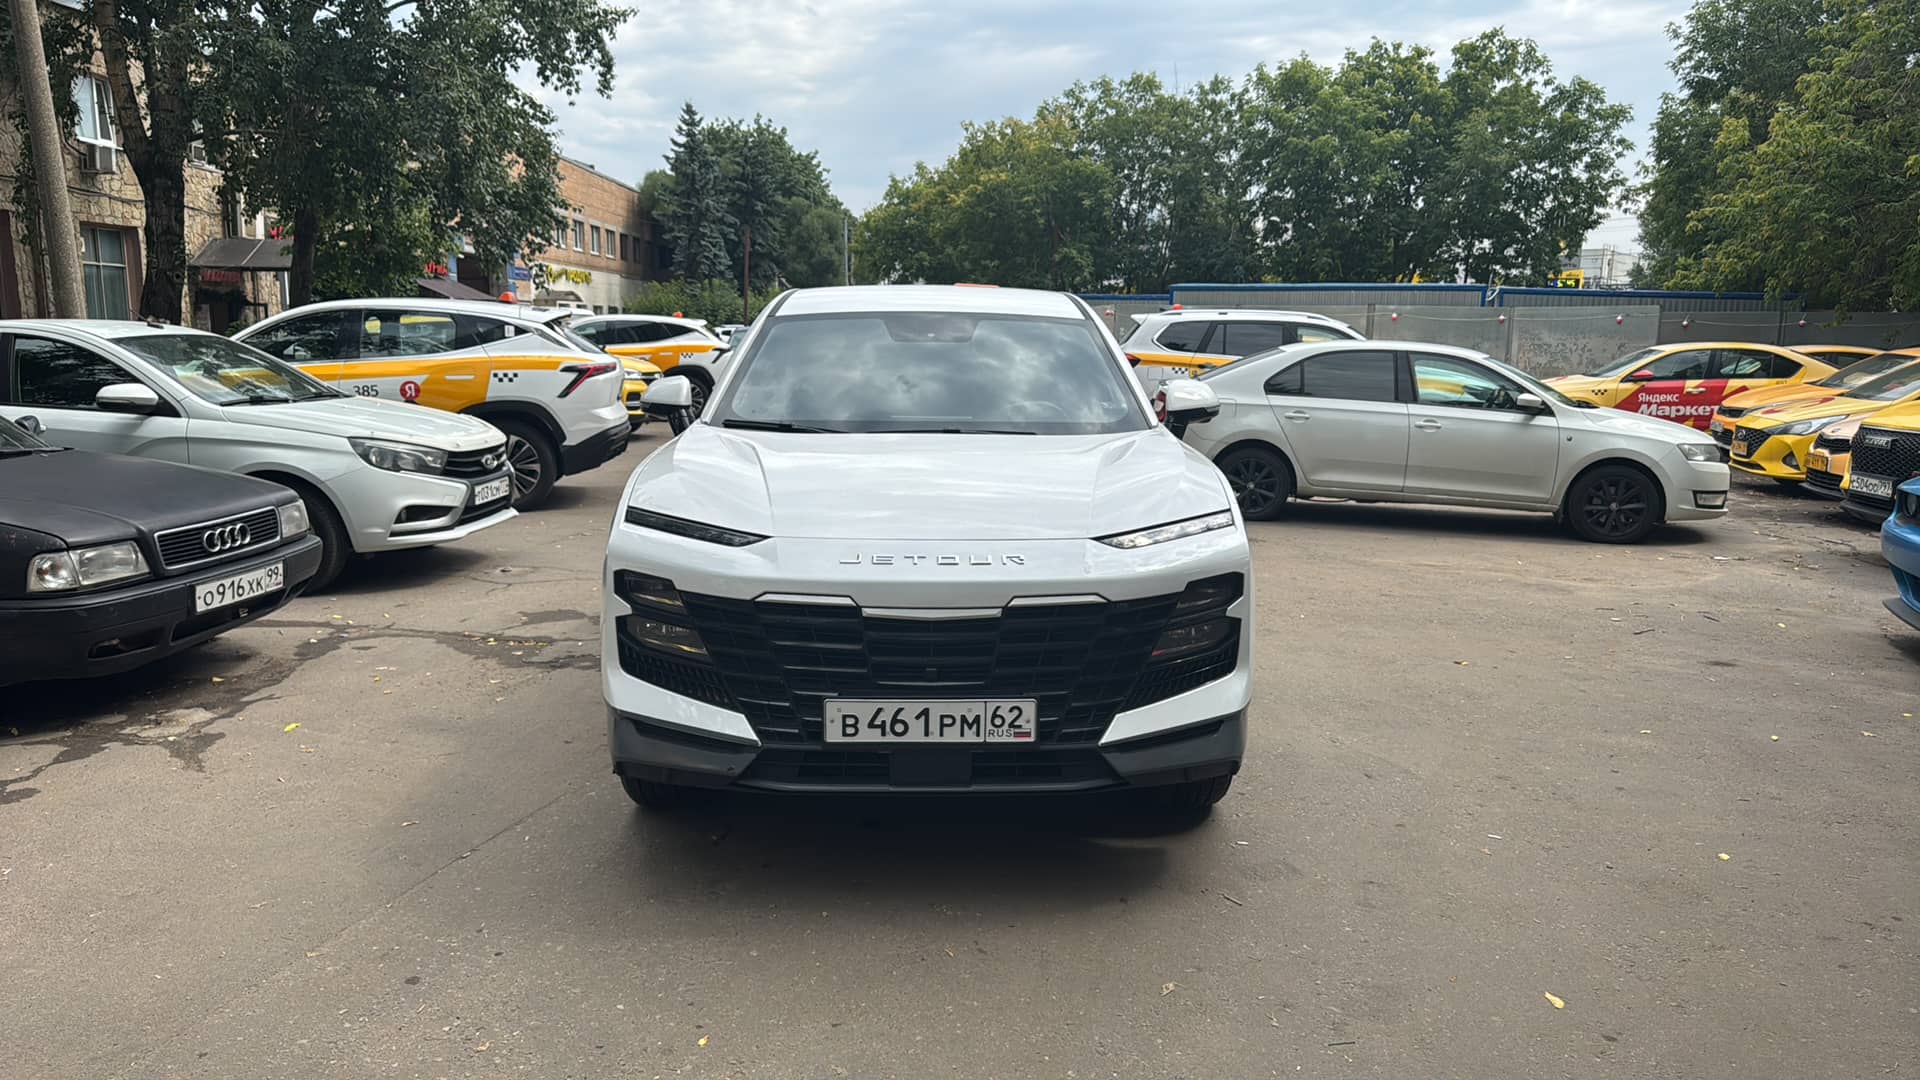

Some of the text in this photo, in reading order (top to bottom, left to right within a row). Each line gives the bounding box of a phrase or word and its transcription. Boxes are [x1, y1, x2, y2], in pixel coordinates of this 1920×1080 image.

[353, 384, 379, 397] 385
[1638, 393, 1680, 403] Яндекс
[1638, 404, 1719, 418] Маркет
[839, 553, 1024, 565] JETOUR
[203, 566, 279, 606] О916ХК 99
[990, 705, 1023, 728] 62
[988, 729, 1012, 738] RUS
